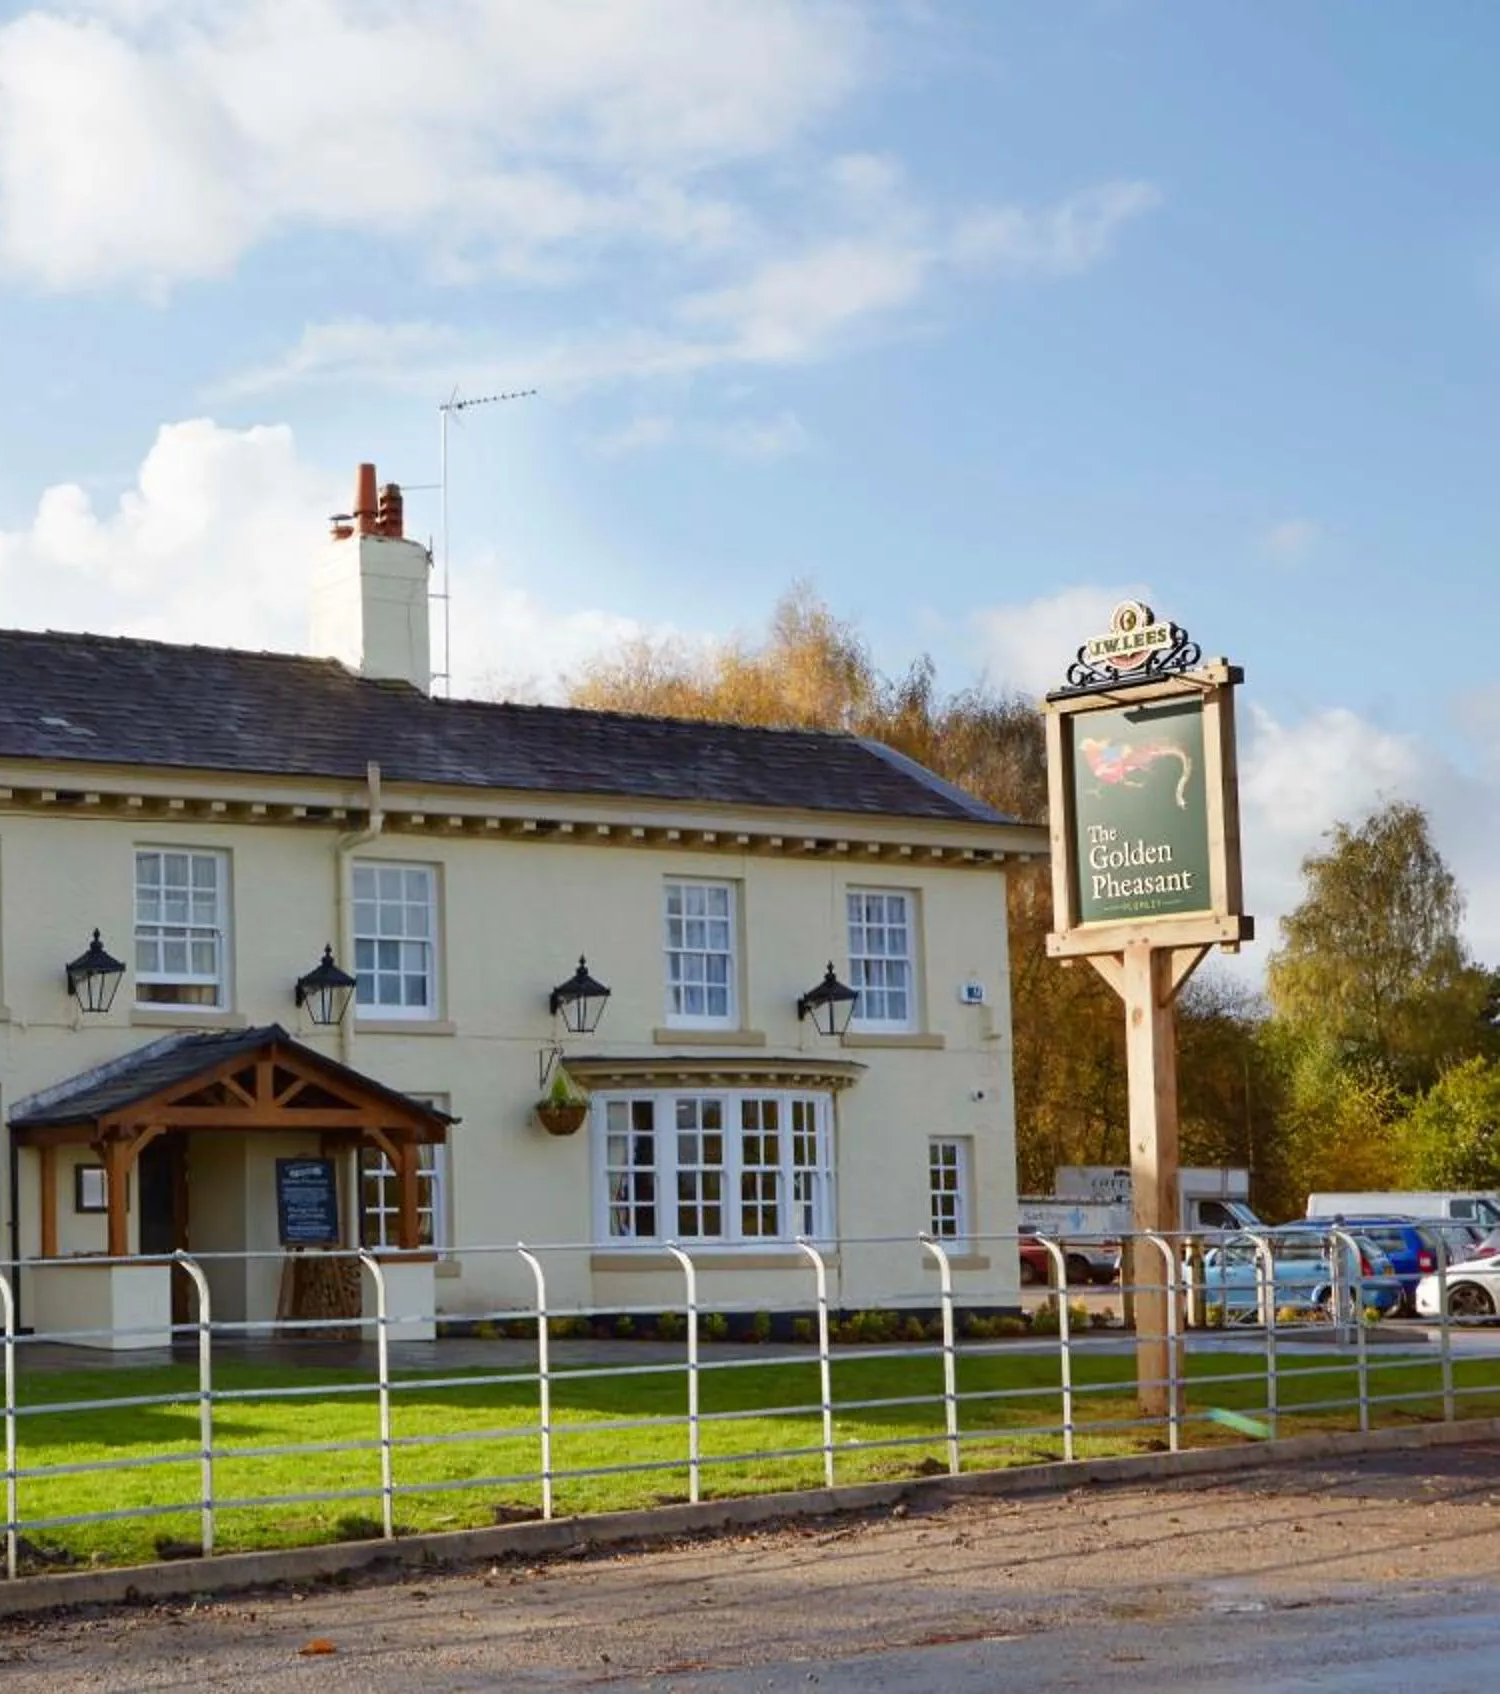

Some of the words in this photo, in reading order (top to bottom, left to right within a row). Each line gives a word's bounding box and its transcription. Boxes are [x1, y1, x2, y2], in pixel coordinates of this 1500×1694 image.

[1087, 825, 1117, 842] The
[1089, 839, 1172, 869] Golden
[1091, 870, 1192, 899] Pheasant
